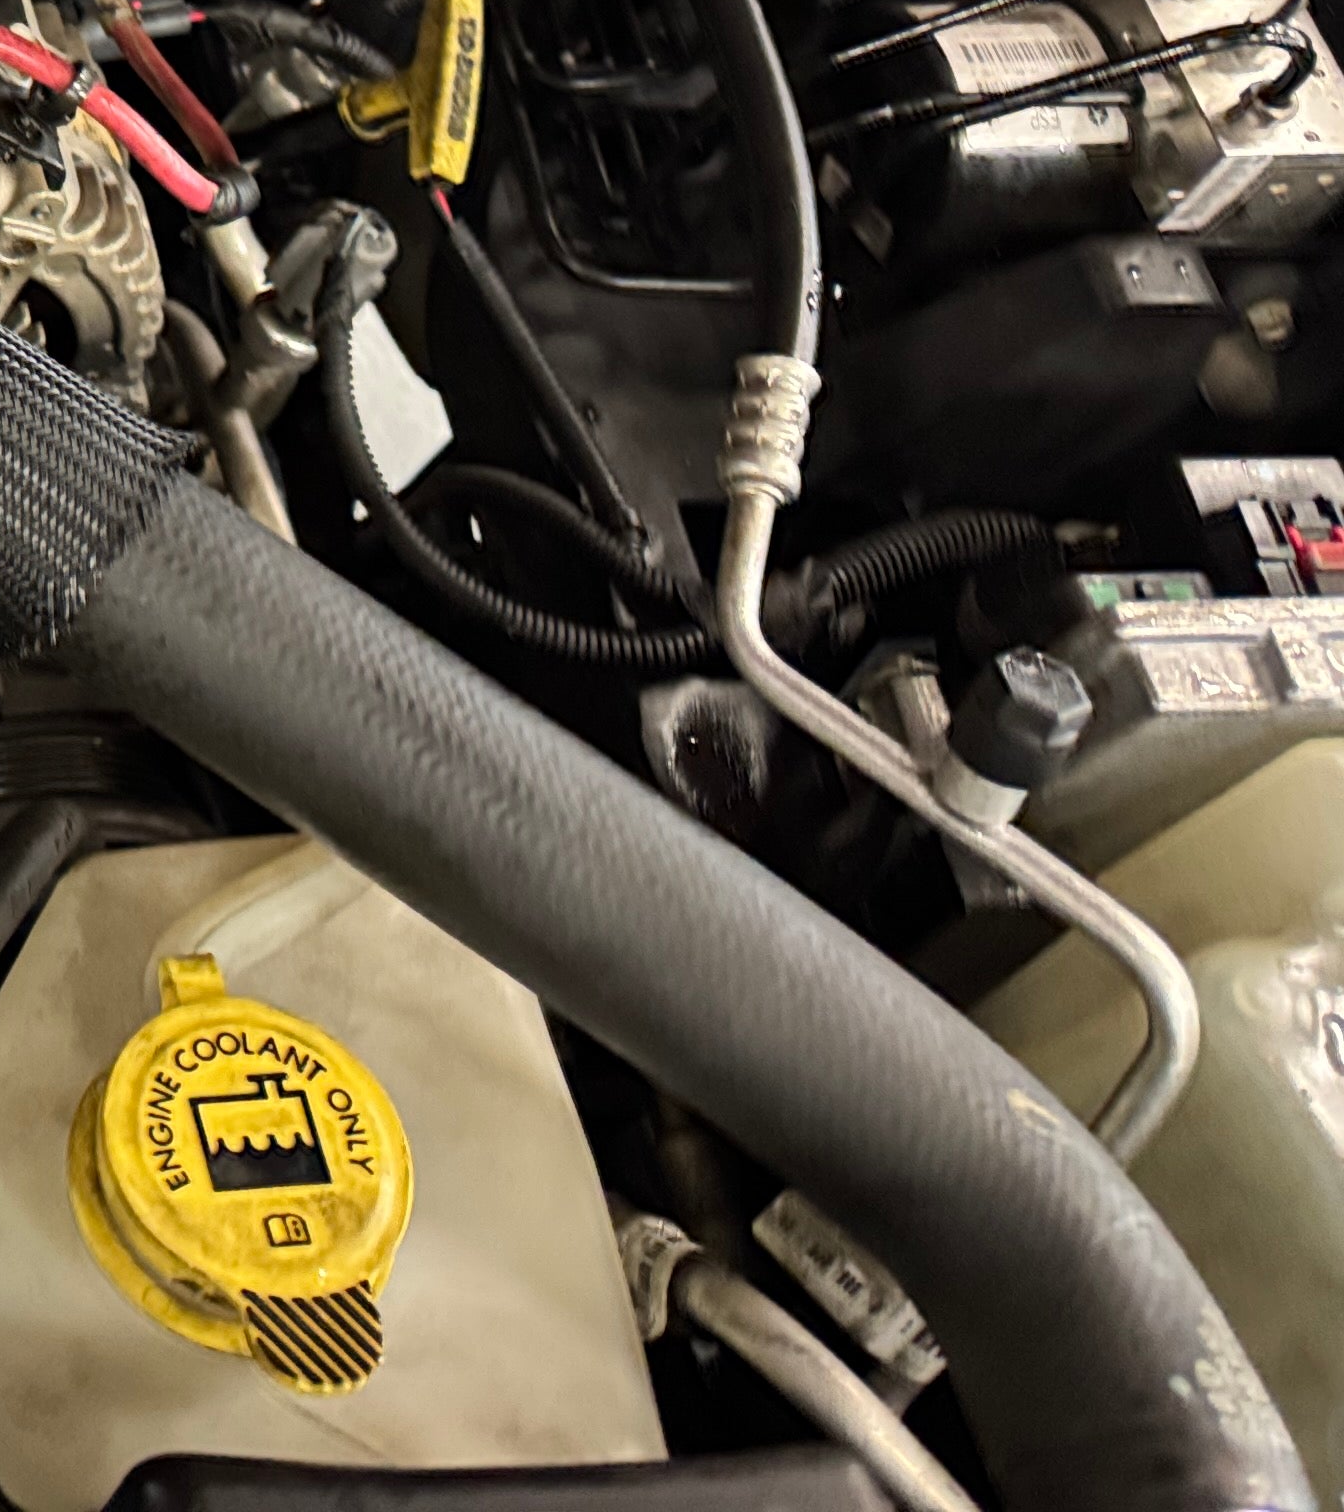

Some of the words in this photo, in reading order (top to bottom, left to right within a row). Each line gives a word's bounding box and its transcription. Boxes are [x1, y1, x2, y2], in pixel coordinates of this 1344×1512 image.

[148, 1071, 191, 1192] ENGINE
[174, 1031, 328, 1081] COOLANT
[326, 1087, 375, 1176] ONLY
